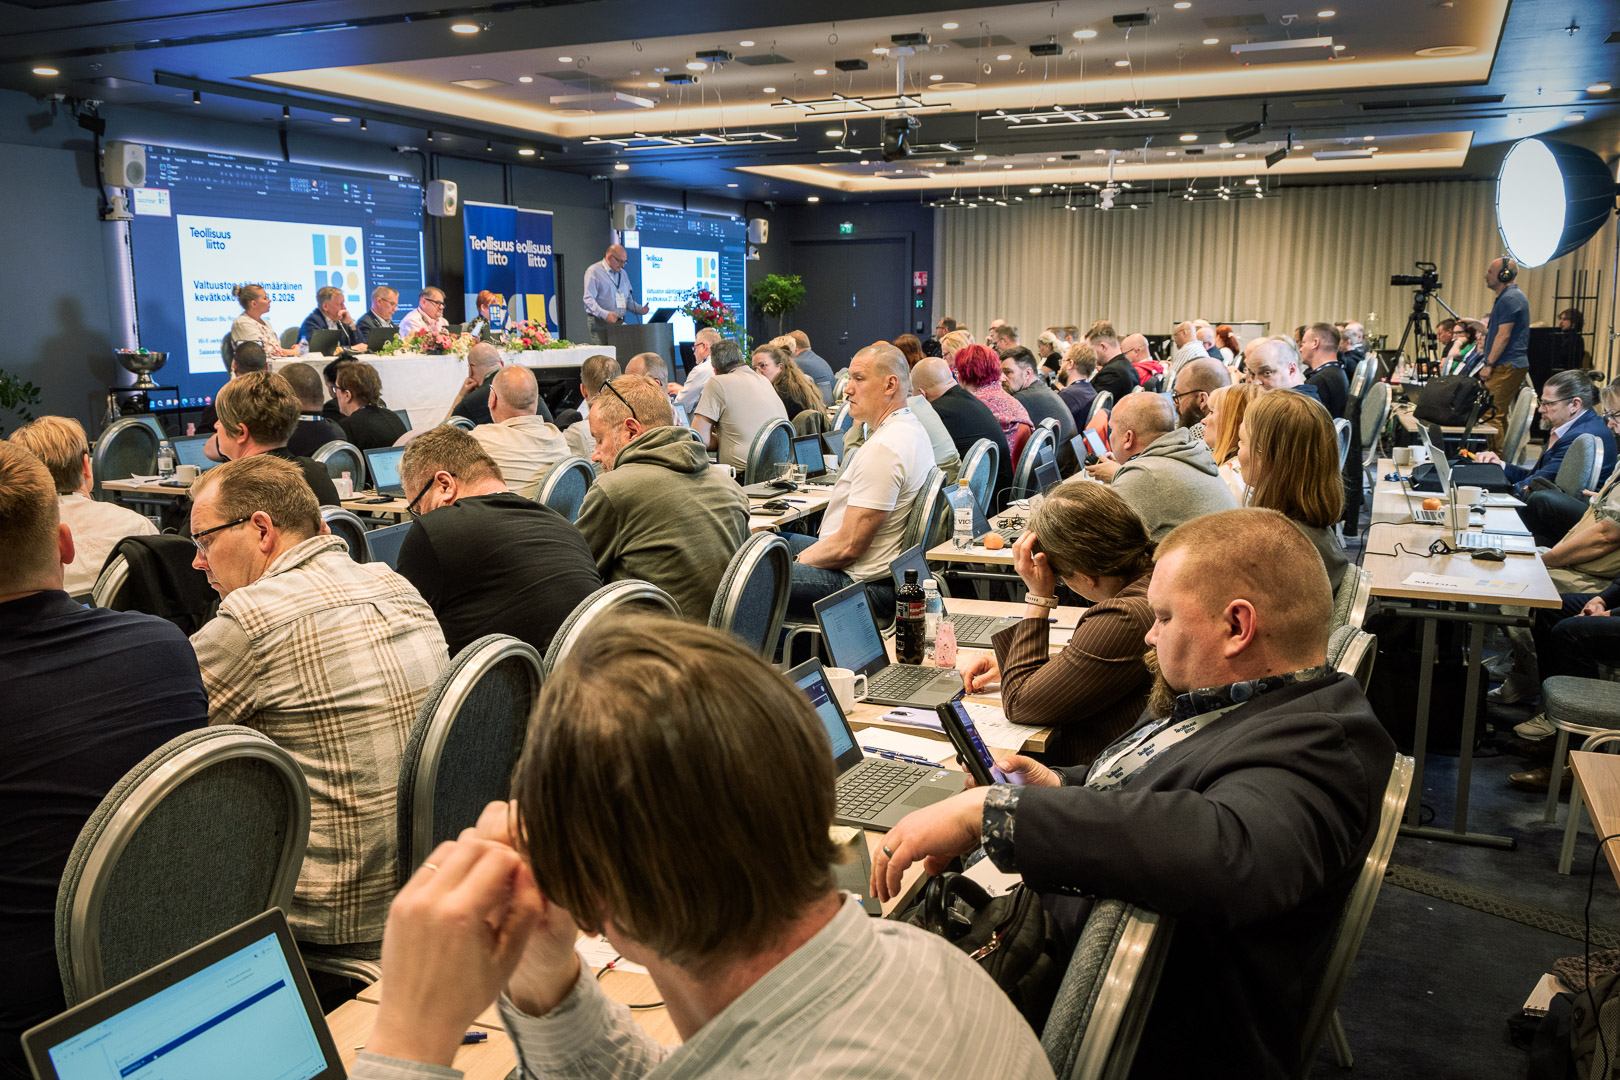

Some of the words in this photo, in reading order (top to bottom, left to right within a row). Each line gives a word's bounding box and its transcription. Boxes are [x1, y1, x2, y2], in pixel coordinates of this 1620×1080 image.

[189, 226, 231, 239] Teollisuus
[206, 238, 226, 250] liitto
[469, 235, 515, 252] Teollisuus
[516, 239, 552, 255] eollisuus
[487, 250, 508, 266] liitto
[528, 253, 547, 268] liitto
[194, 292, 238, 302] kevätkoko
